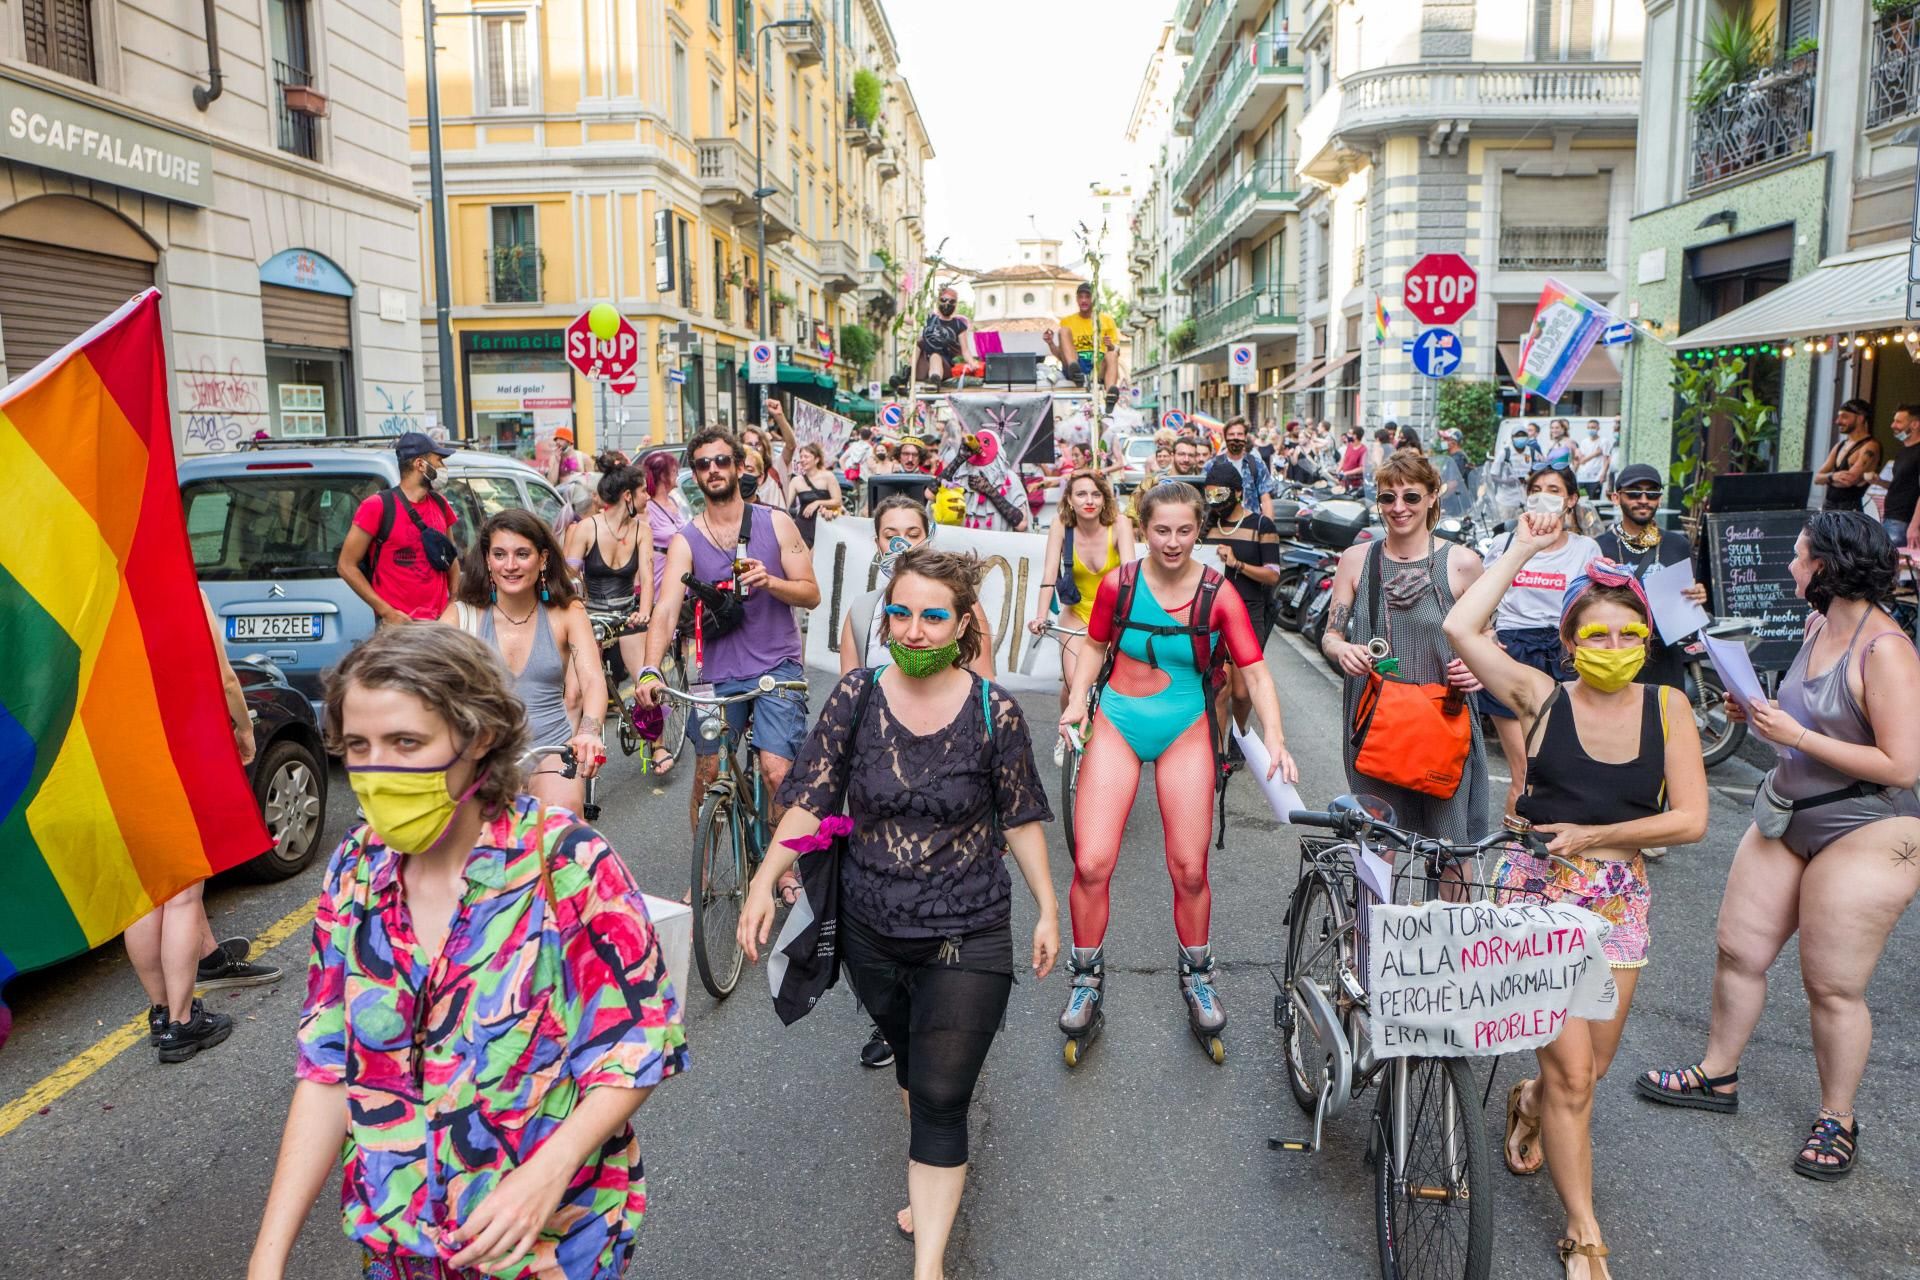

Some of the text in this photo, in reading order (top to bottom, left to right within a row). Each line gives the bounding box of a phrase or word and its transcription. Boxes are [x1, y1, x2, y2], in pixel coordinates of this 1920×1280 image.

[9, 107, 200, 186] SCAFFALATURE
[1407, 275, 1474, 303] STOP
[472, 335, 562, 349] farmacia
[570, 331, 634, 359] STOP
[497, 385, 545, 395] Mal di gola?
[1728, 544, 1760, 555] SPECIAL 1
[1728, 555, 1762, 567] SPECIAL 2
[1515, 572, 1564, 587] Gattara
[237, 618, 256, 635] BW
[262, 617, 310, 636] 262EE
[1382, 911, 1431, 944] NON
[1381, 945, 1455, 978] ALLA
[1459, 981, 1485, 1010] LA
[1384, 1008, 1568, 1048] ERA IL PROBLEM
